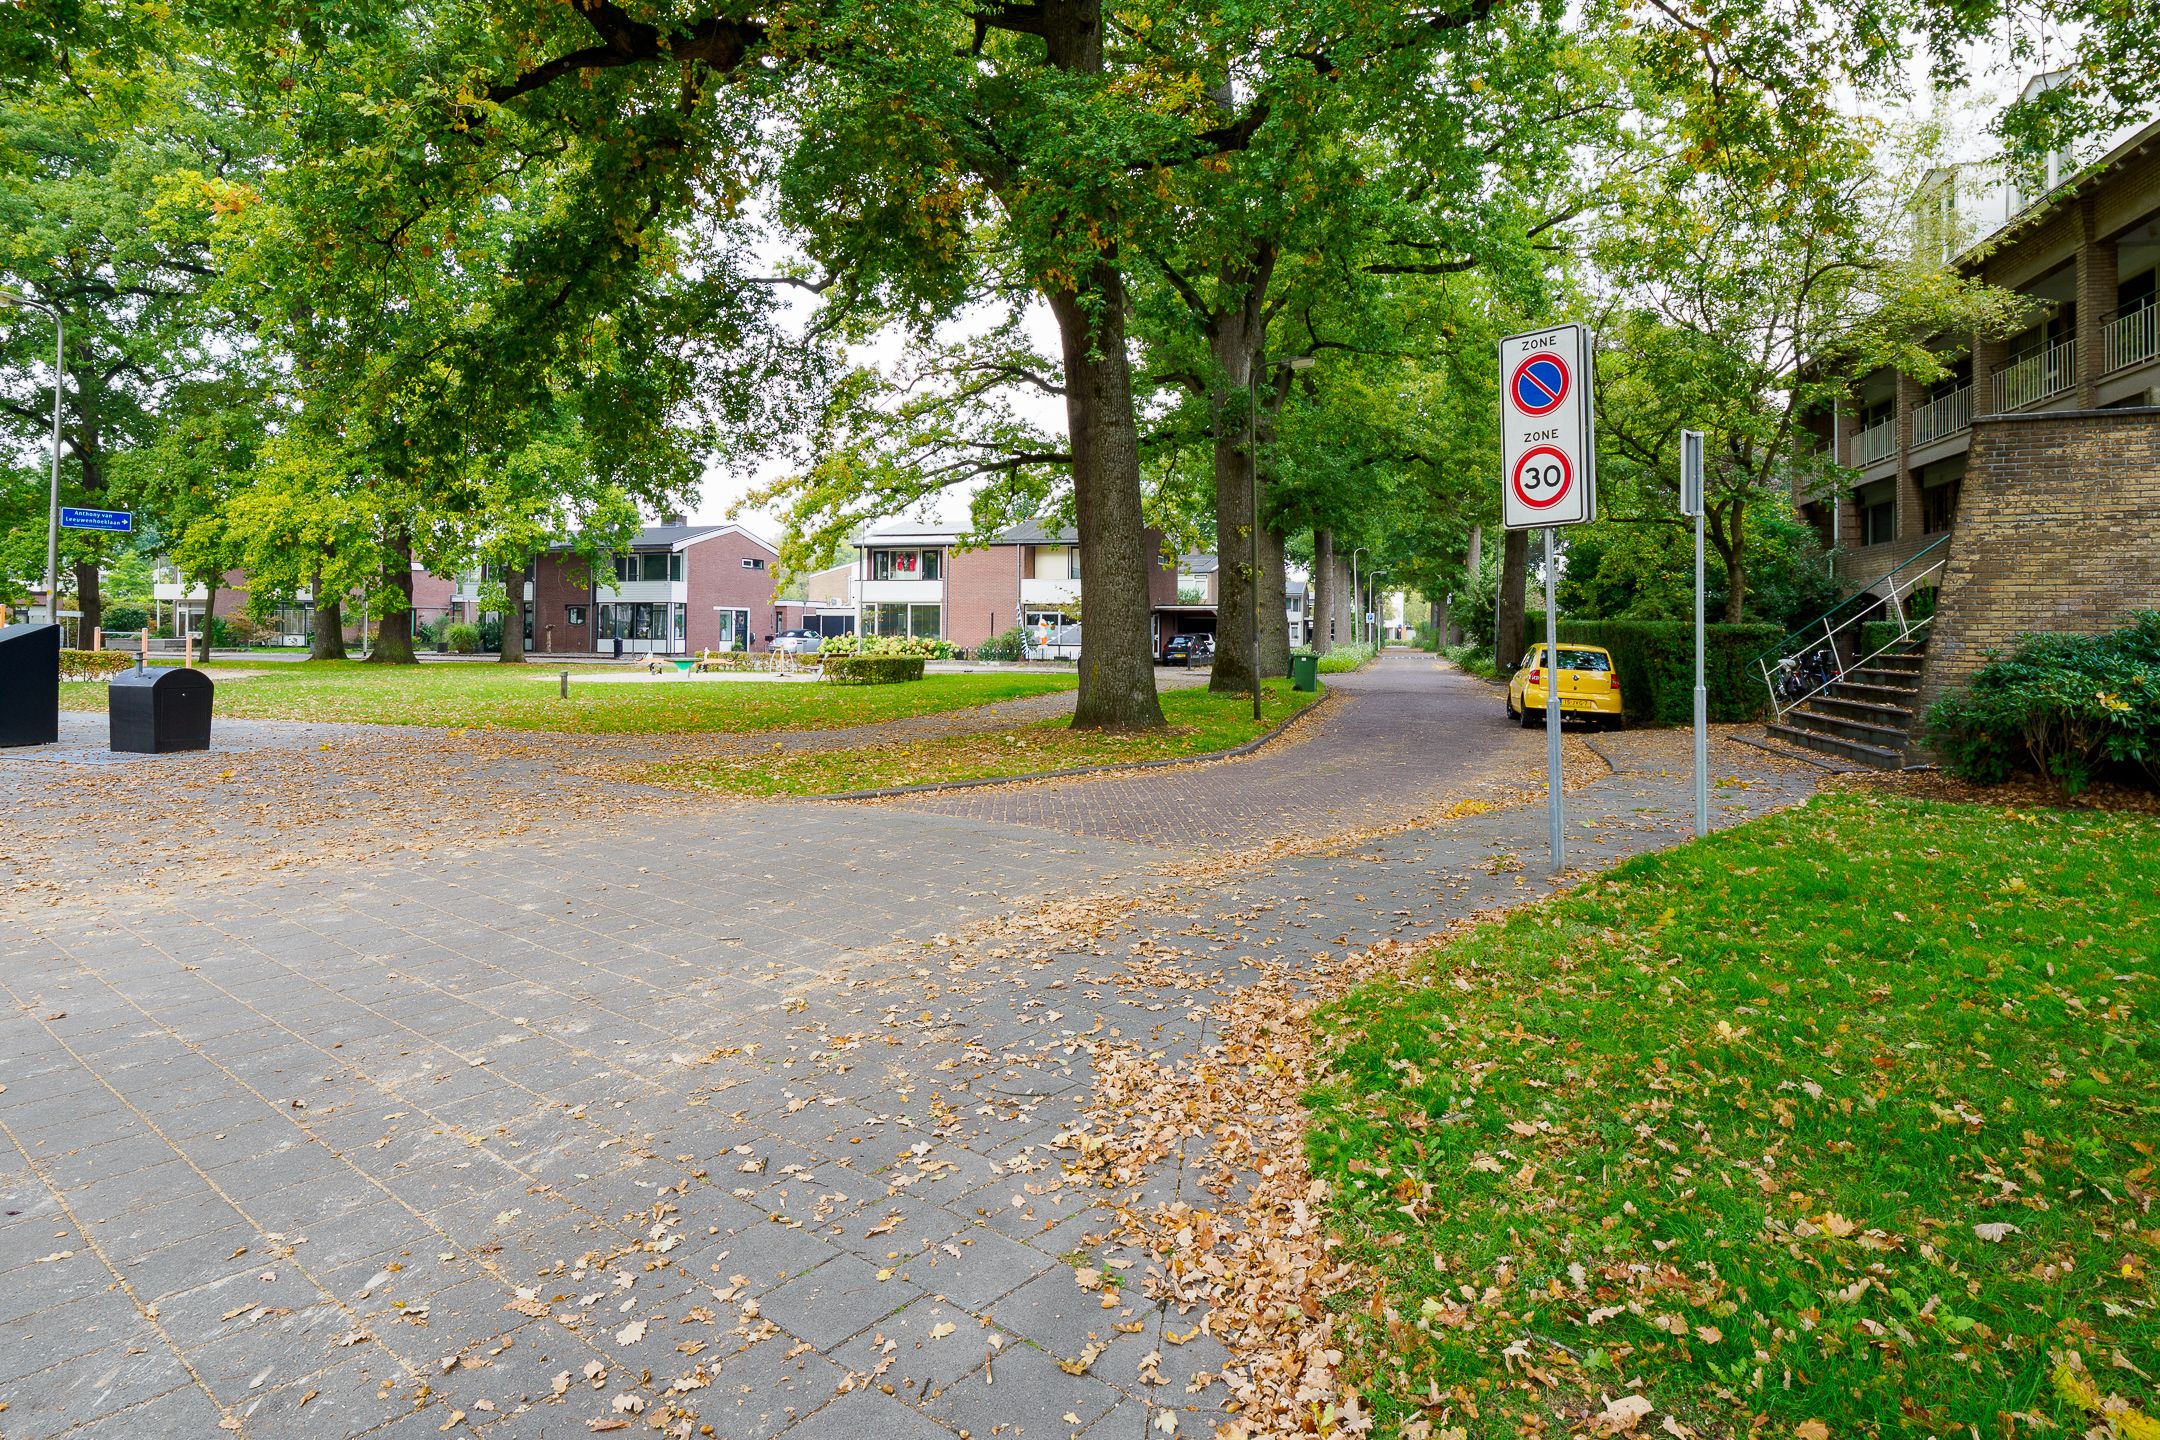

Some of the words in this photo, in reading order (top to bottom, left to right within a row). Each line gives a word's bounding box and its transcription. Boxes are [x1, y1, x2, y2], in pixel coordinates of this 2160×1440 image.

[1522, 335, 1557, 351] ZONE
[1524, 428, 1559, 443] ZONE
[1524, 464, 1561, 490] 30
[65, 516, 120, 525] Leeuwenhoeklaan
[74, 510, 100, 518] Anthony
